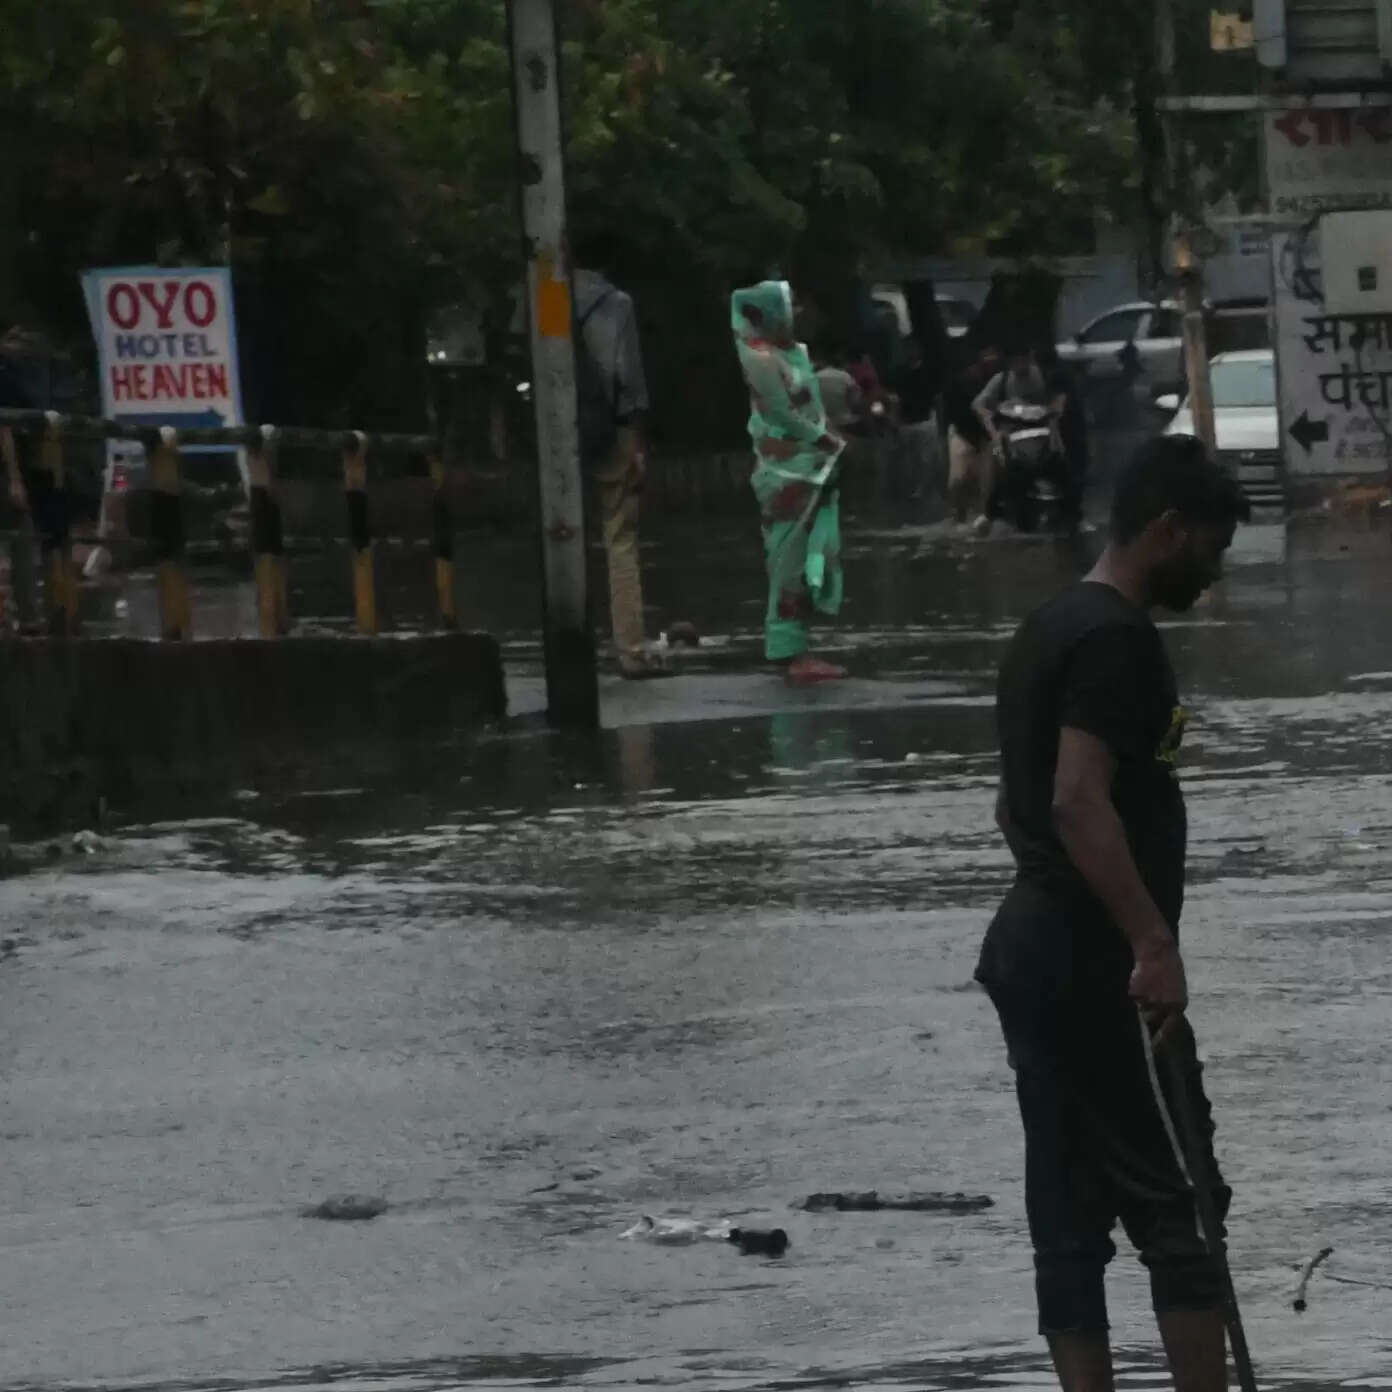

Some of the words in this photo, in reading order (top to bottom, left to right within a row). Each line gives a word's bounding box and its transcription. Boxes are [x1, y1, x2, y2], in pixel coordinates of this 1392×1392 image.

[107, 281, 216, 330] OYO
[115, 333, 219, 358] HOTEL
[111, 363, 228, 401] HEAVEN
